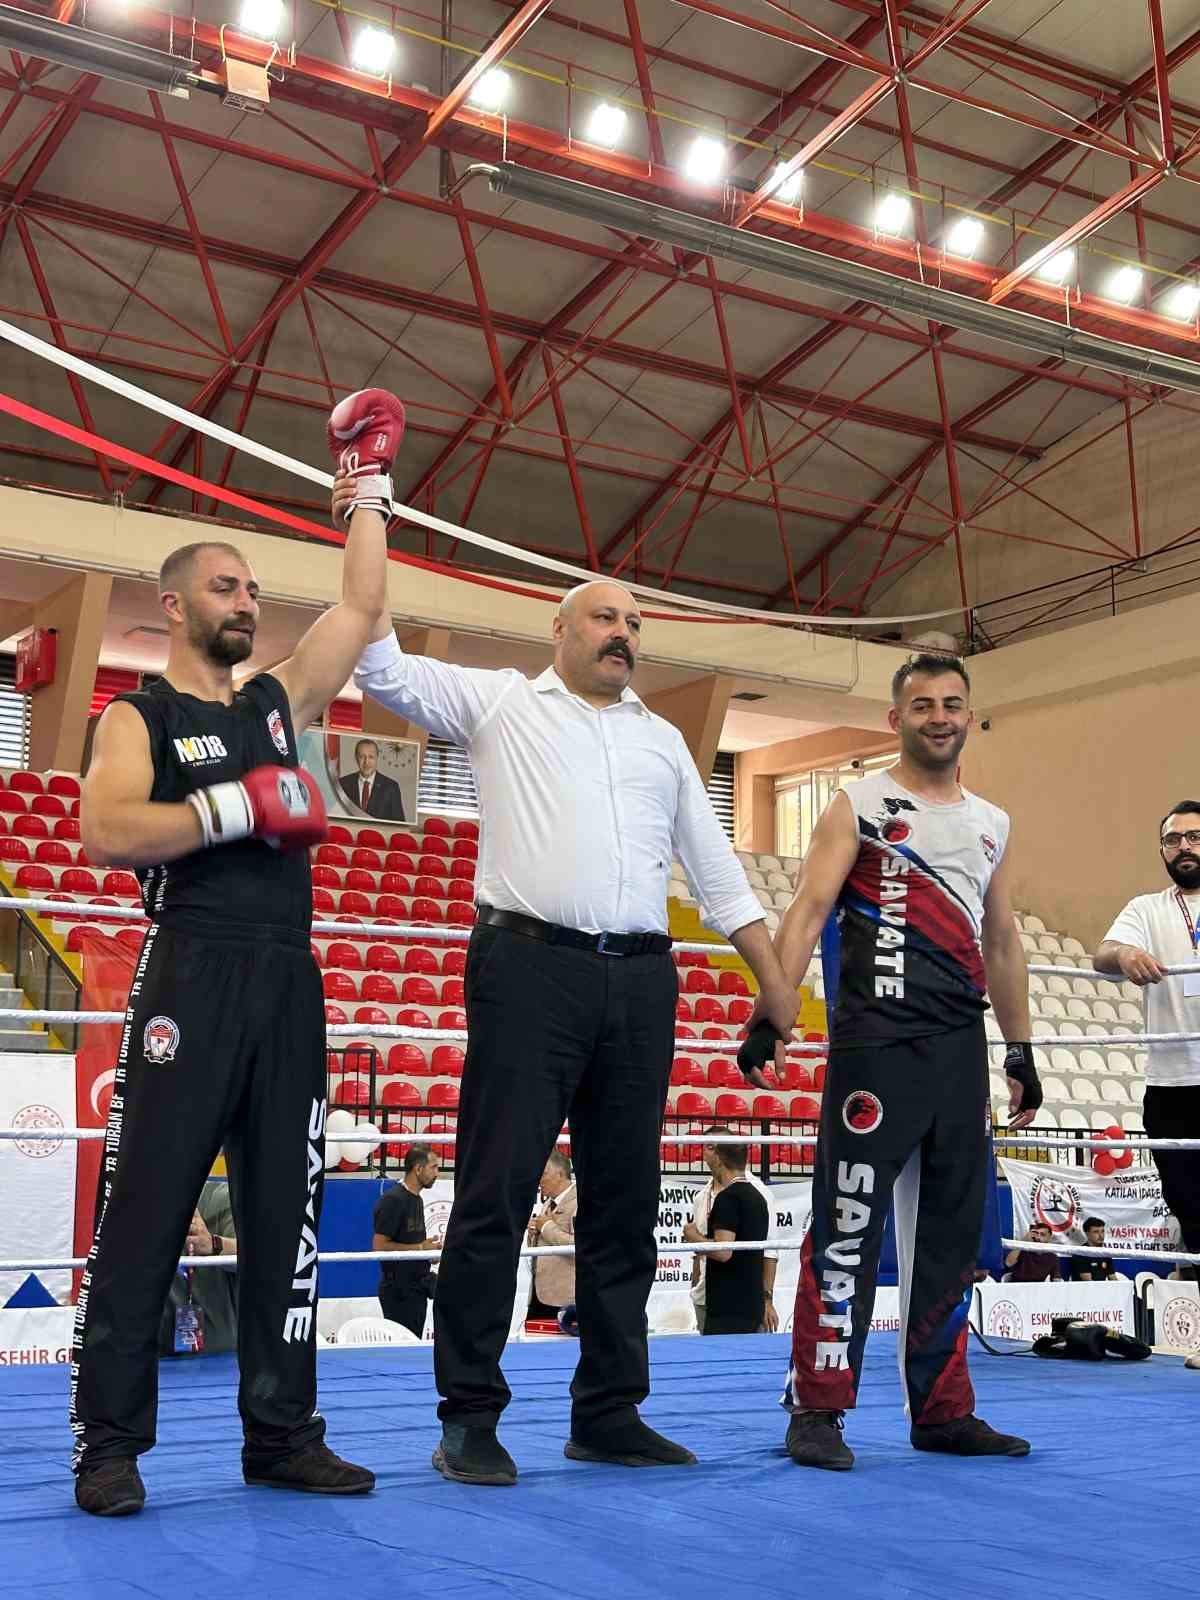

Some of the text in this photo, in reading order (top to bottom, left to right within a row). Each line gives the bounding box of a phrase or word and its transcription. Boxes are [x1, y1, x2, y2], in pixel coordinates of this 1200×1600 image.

[874, 856, 911, 999] SAVATE
[776, 1211, 793, 1227] RA
[815, 1160, 875, 1371] SAVATE
